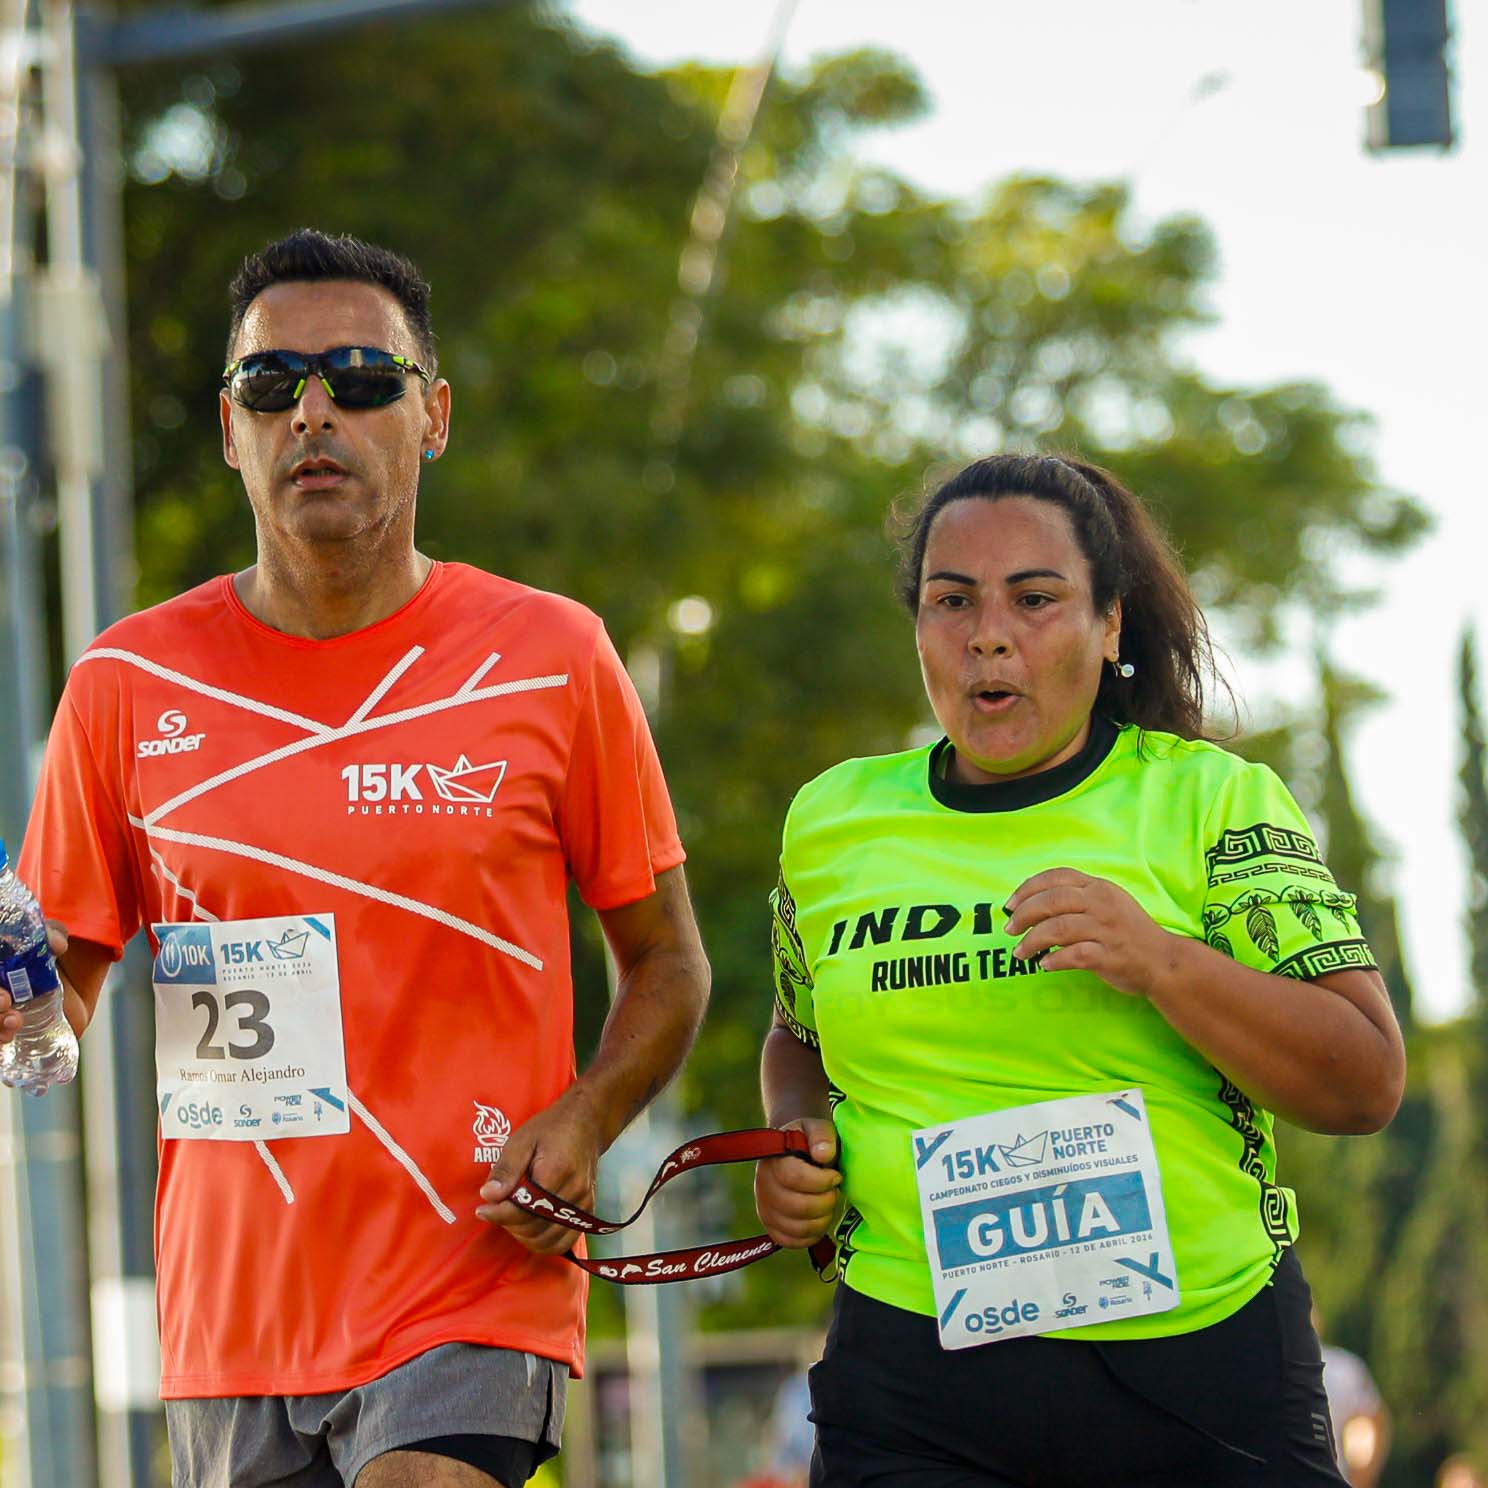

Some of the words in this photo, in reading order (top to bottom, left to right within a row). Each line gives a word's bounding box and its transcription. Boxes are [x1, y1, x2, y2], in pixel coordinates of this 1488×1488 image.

[341, 762, 423, 802] 15K
[347, 804, 424, 816] PUERTO
[431, 804, 494, 817] NORTE
[182, 944, 211, 966] 10K
[220, 940, 265, 965] 15K
[871, 952, 970, 993] RUNING
[191, 989, 275, 1060] 23
[209, 1068, 237, 1083] Omar
[240, 1065, 305, 1084] Alejandro
[177, 1100, 223, 1128] osde
[1050, 1123, 1114, 1145] PUERTO
[474, 1147, 503, 1163] ARD
[941, 1143, 1001, 1182] 15K
[1053, 1139, 1107, 1160] NORTE
[929, 1182, 988, 1201] CAMPEONATO
[990, 1175, 1023, 1188] CIEGOS
[1023, 1173, 1031, 1182] Y
[1092, 1154, 1139, 1168] VISUALES
[553, 1207, 593, 1229] San
[967, 1184, 1121, 1257] GUÍA
[643, 1259, 687, 1277] San
[942, 1267, 977, 1280] PUERTO
[979, 1260, 1009, 1272] NORTE
[1070, 1246, 1080, 1255] 12
[1083, 1243, 1096, 1252] DE
[1099, 1237, 1128, 1249] ABRIL
[965, 1299, 1040, 1334] osde
